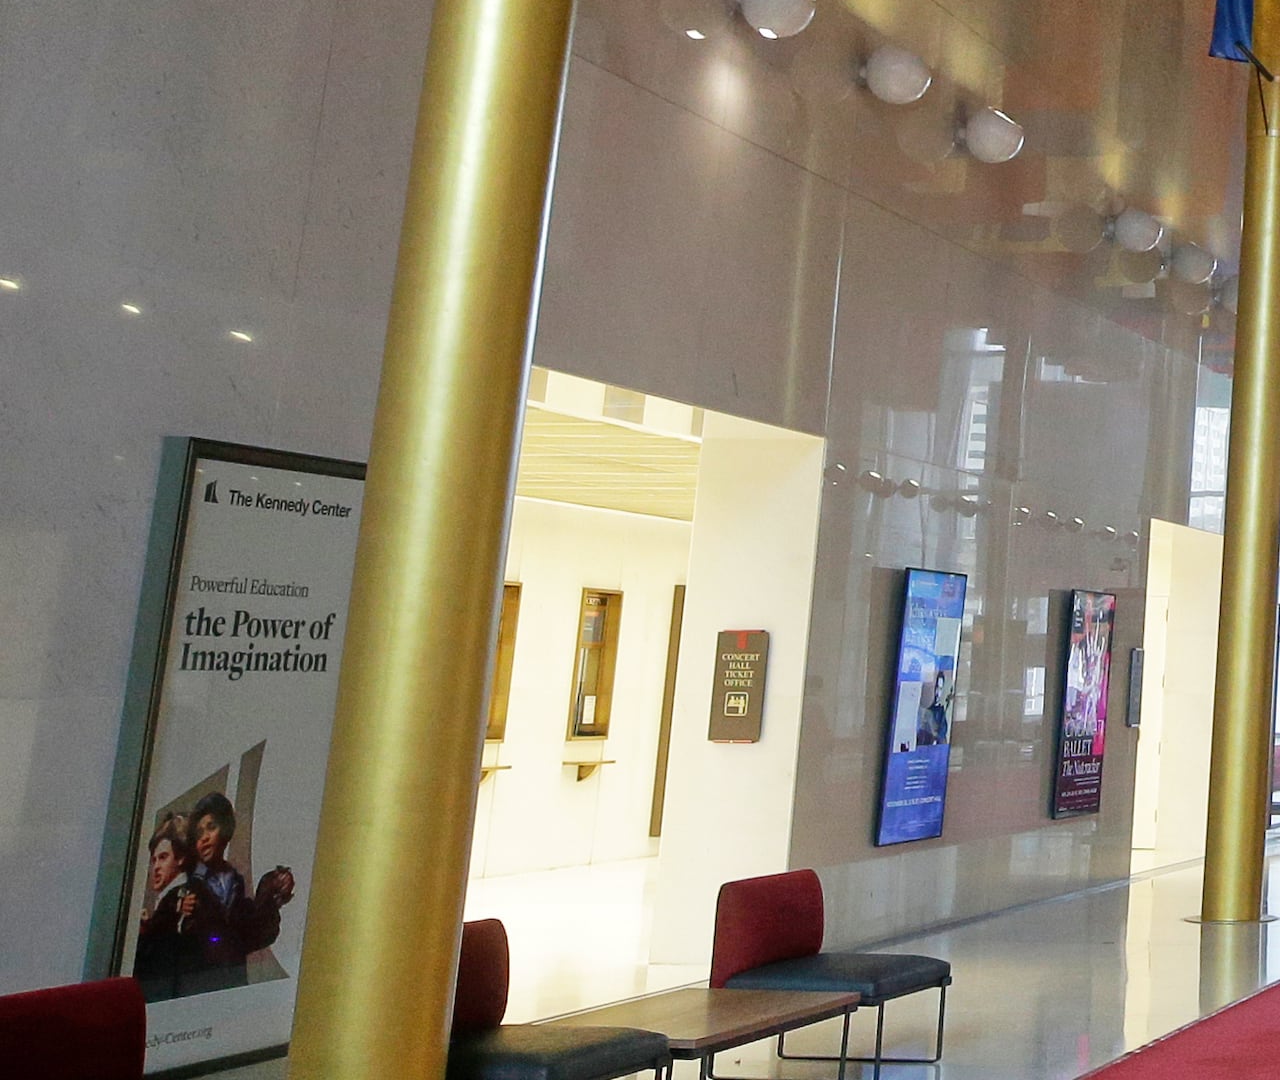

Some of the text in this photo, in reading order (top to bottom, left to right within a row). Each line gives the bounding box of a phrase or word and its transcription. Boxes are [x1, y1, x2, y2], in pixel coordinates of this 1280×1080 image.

[228, 489, 353, 518] The Kennedy Center
[190, 575, 309, 598] Powerful Education
[184, 607, 337, 640] the Power of
[180, 642, 328, 681] Imagination
[722, 653, 760, 661] CONCERT
[724, 679, 753, 687] OFFICE
[725, 670, 754, 678] TICKET
[1063, 739, 1092, 758] BALLET
[145, 1026, 213, 1050] dy-Center.org
